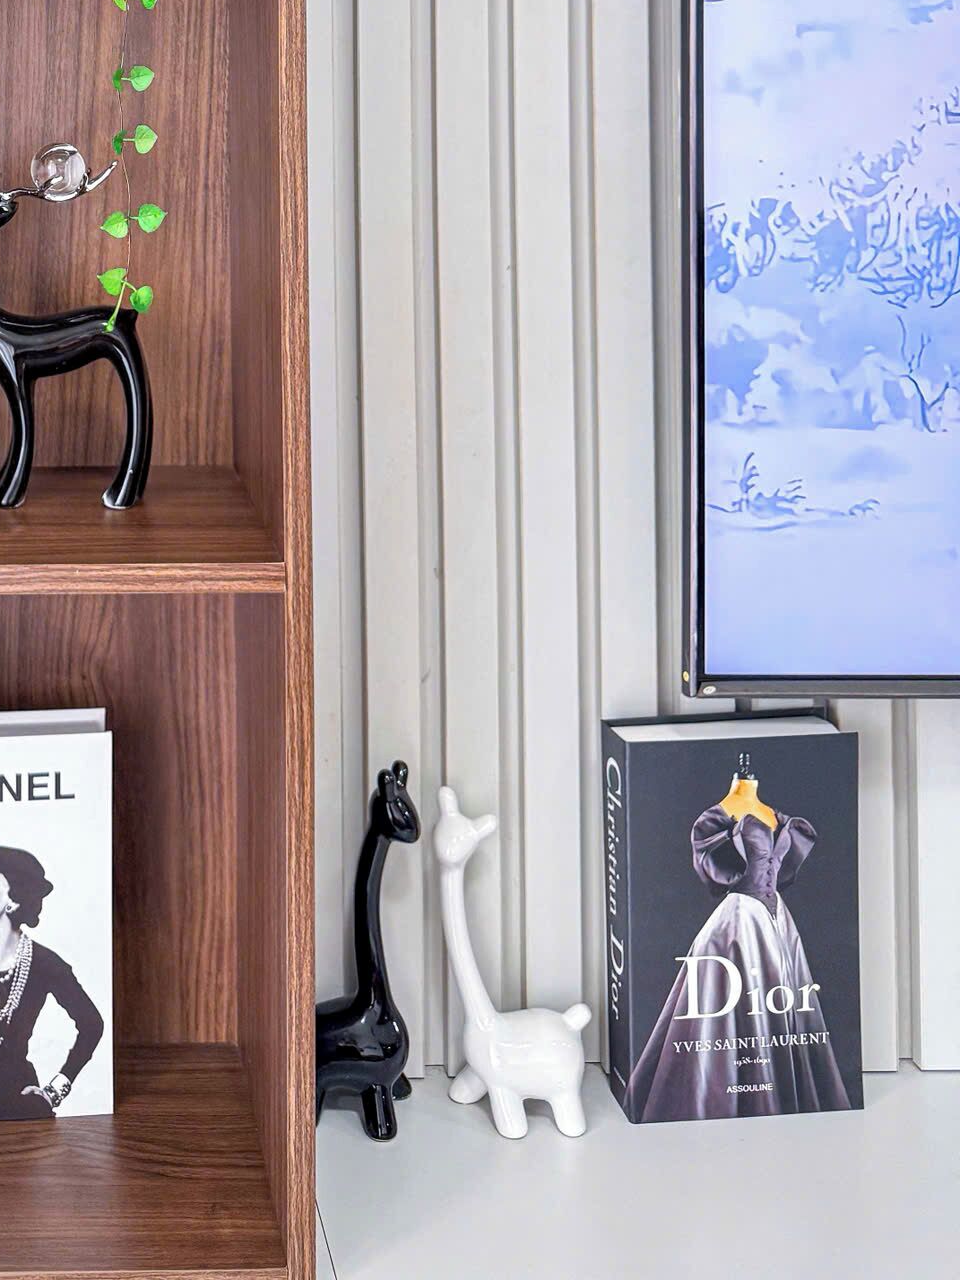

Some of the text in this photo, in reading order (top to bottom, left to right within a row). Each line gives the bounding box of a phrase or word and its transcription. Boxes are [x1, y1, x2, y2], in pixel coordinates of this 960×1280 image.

[606, 756, 625, 1021] Christian Dior
[673, 955, 821, 1020] Dior
[672, 1031, 830, 1053] YVES SAINT LAURENT
[726, 1082, 774, 1094] ASSOULINE
